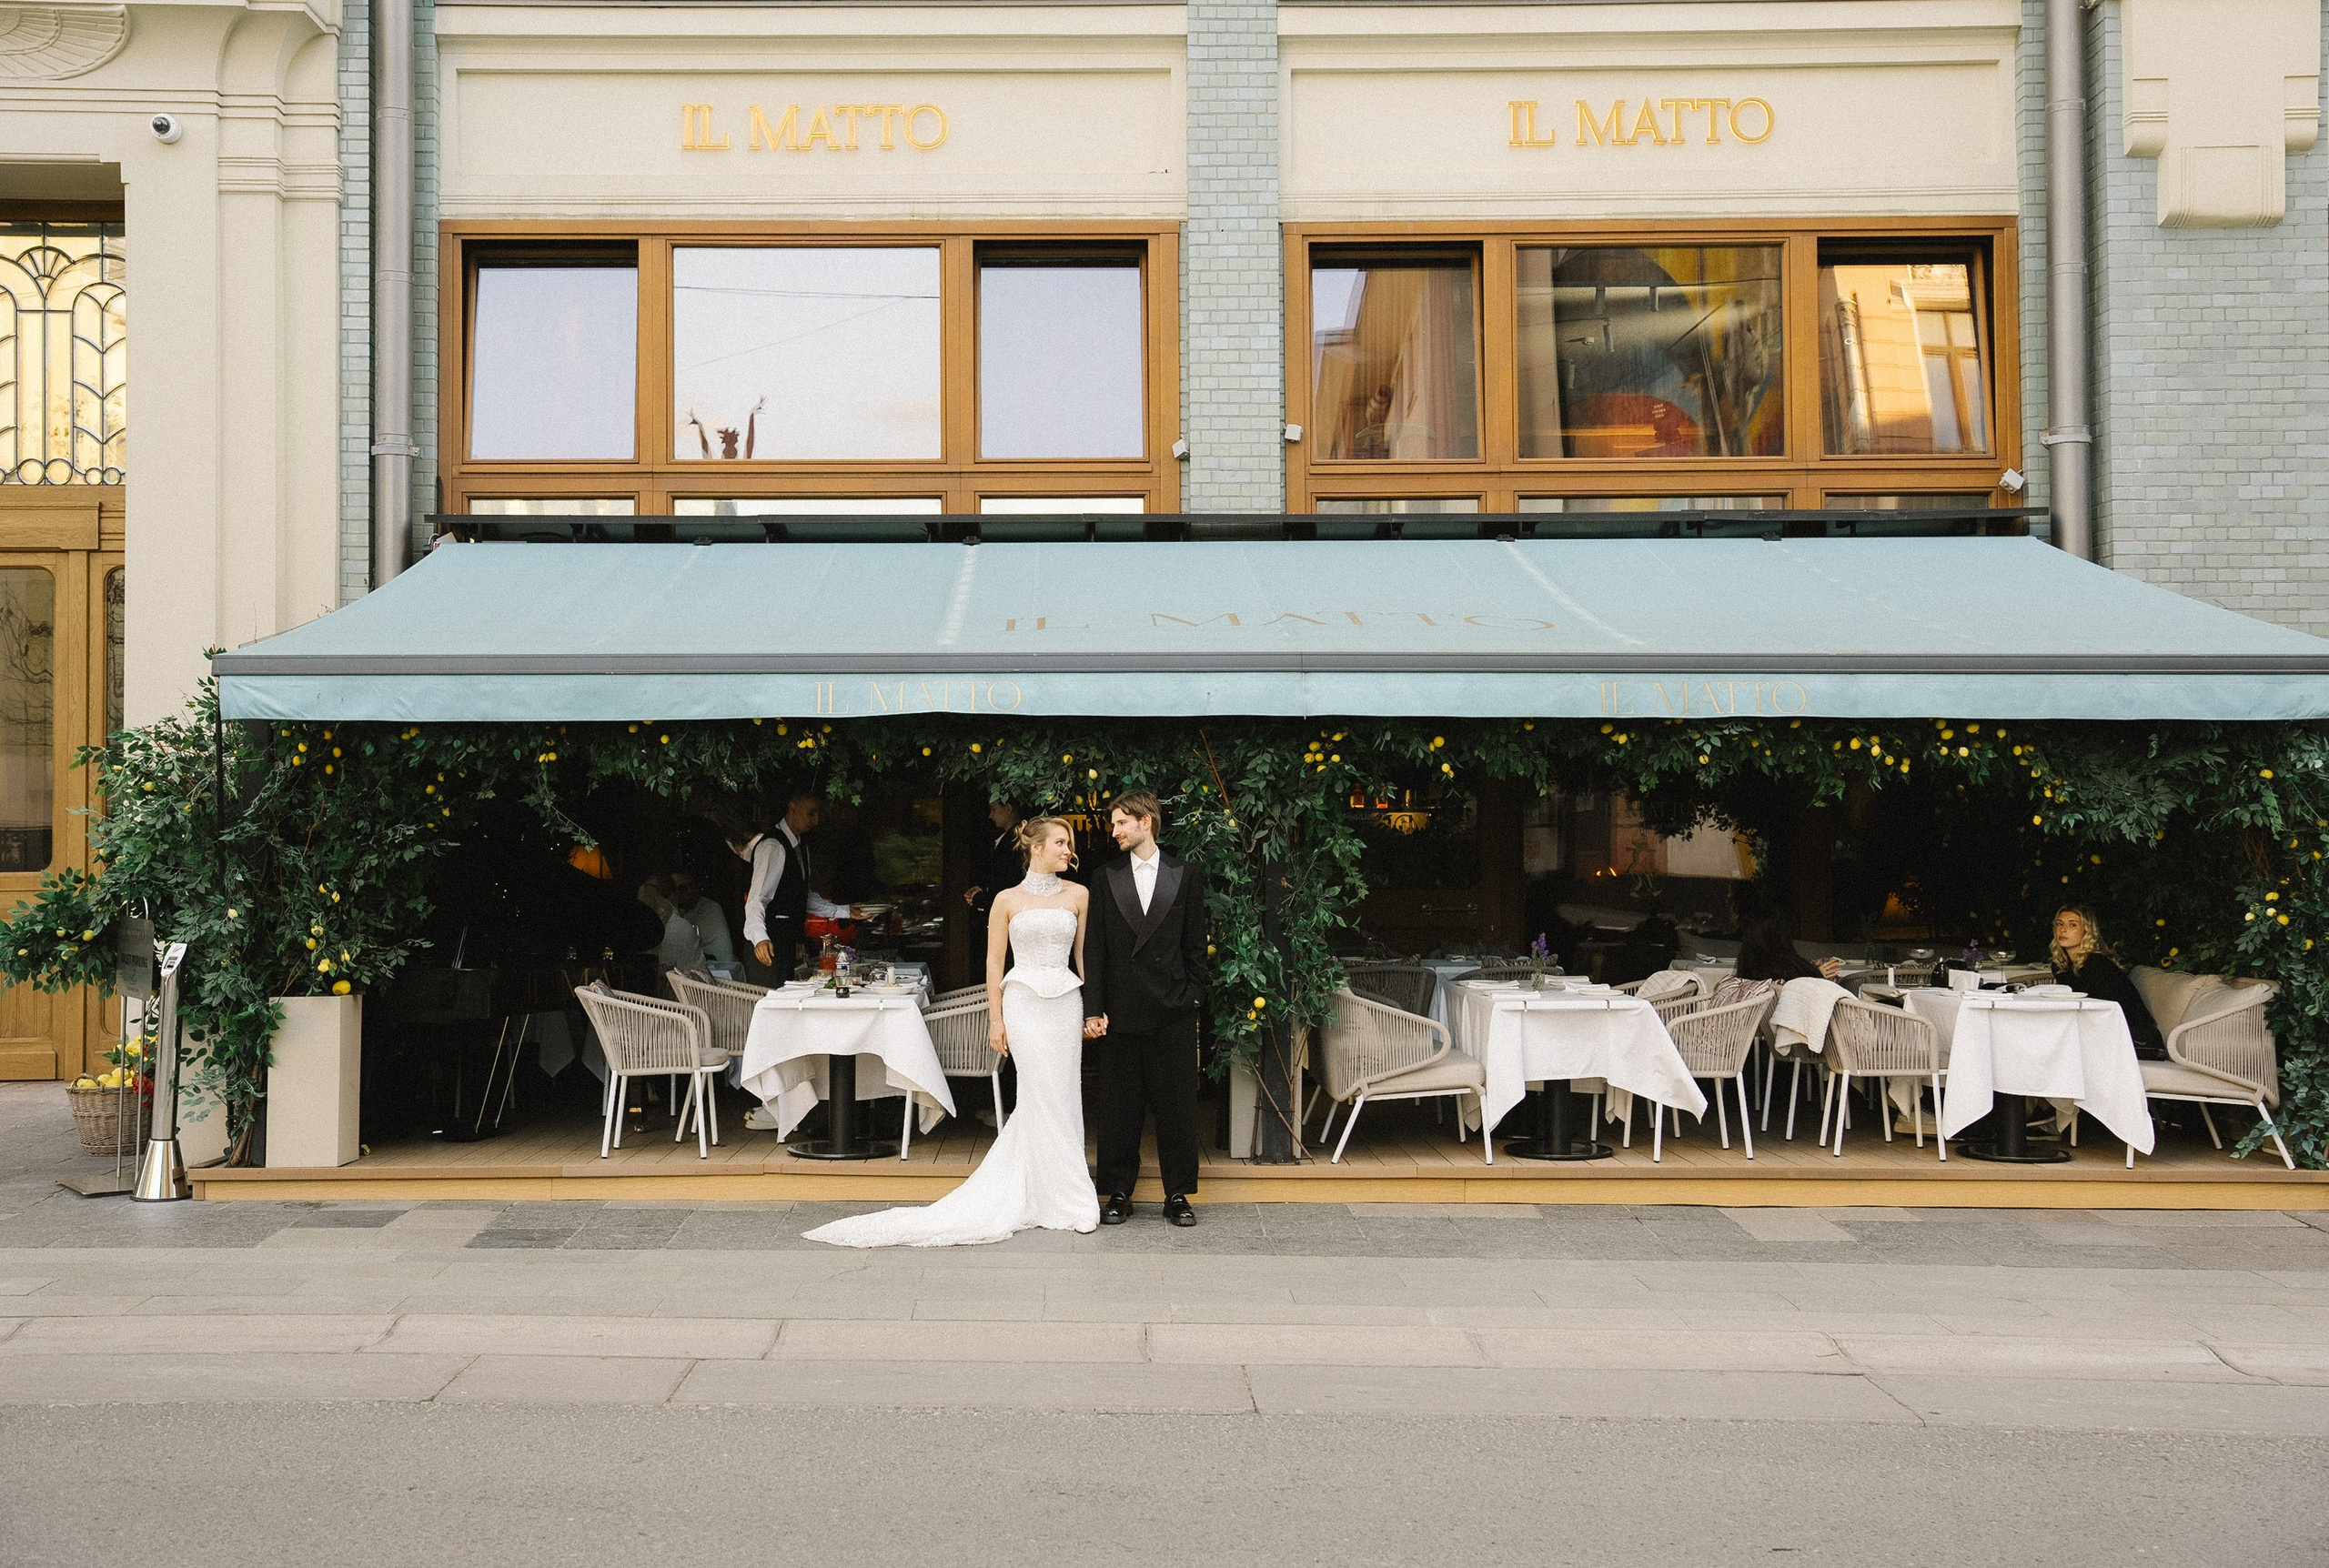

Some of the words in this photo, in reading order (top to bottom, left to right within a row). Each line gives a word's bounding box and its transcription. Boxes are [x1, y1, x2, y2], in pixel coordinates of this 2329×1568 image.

[681, 103, 730, 149] IL
[748, 102, 949, 149] MATTO
[1507, 100, 1556, 146] IL
[1575, 96, 1775, 146] MATTO
[1150, 611, 1556, 632] MATTO
[814, 681, 850, 716] IL
[867, 680, 1023, 713] MATTO
[1598, 680, 1635, 715] IL
[1652, 680, 1809, 715] MATTO
